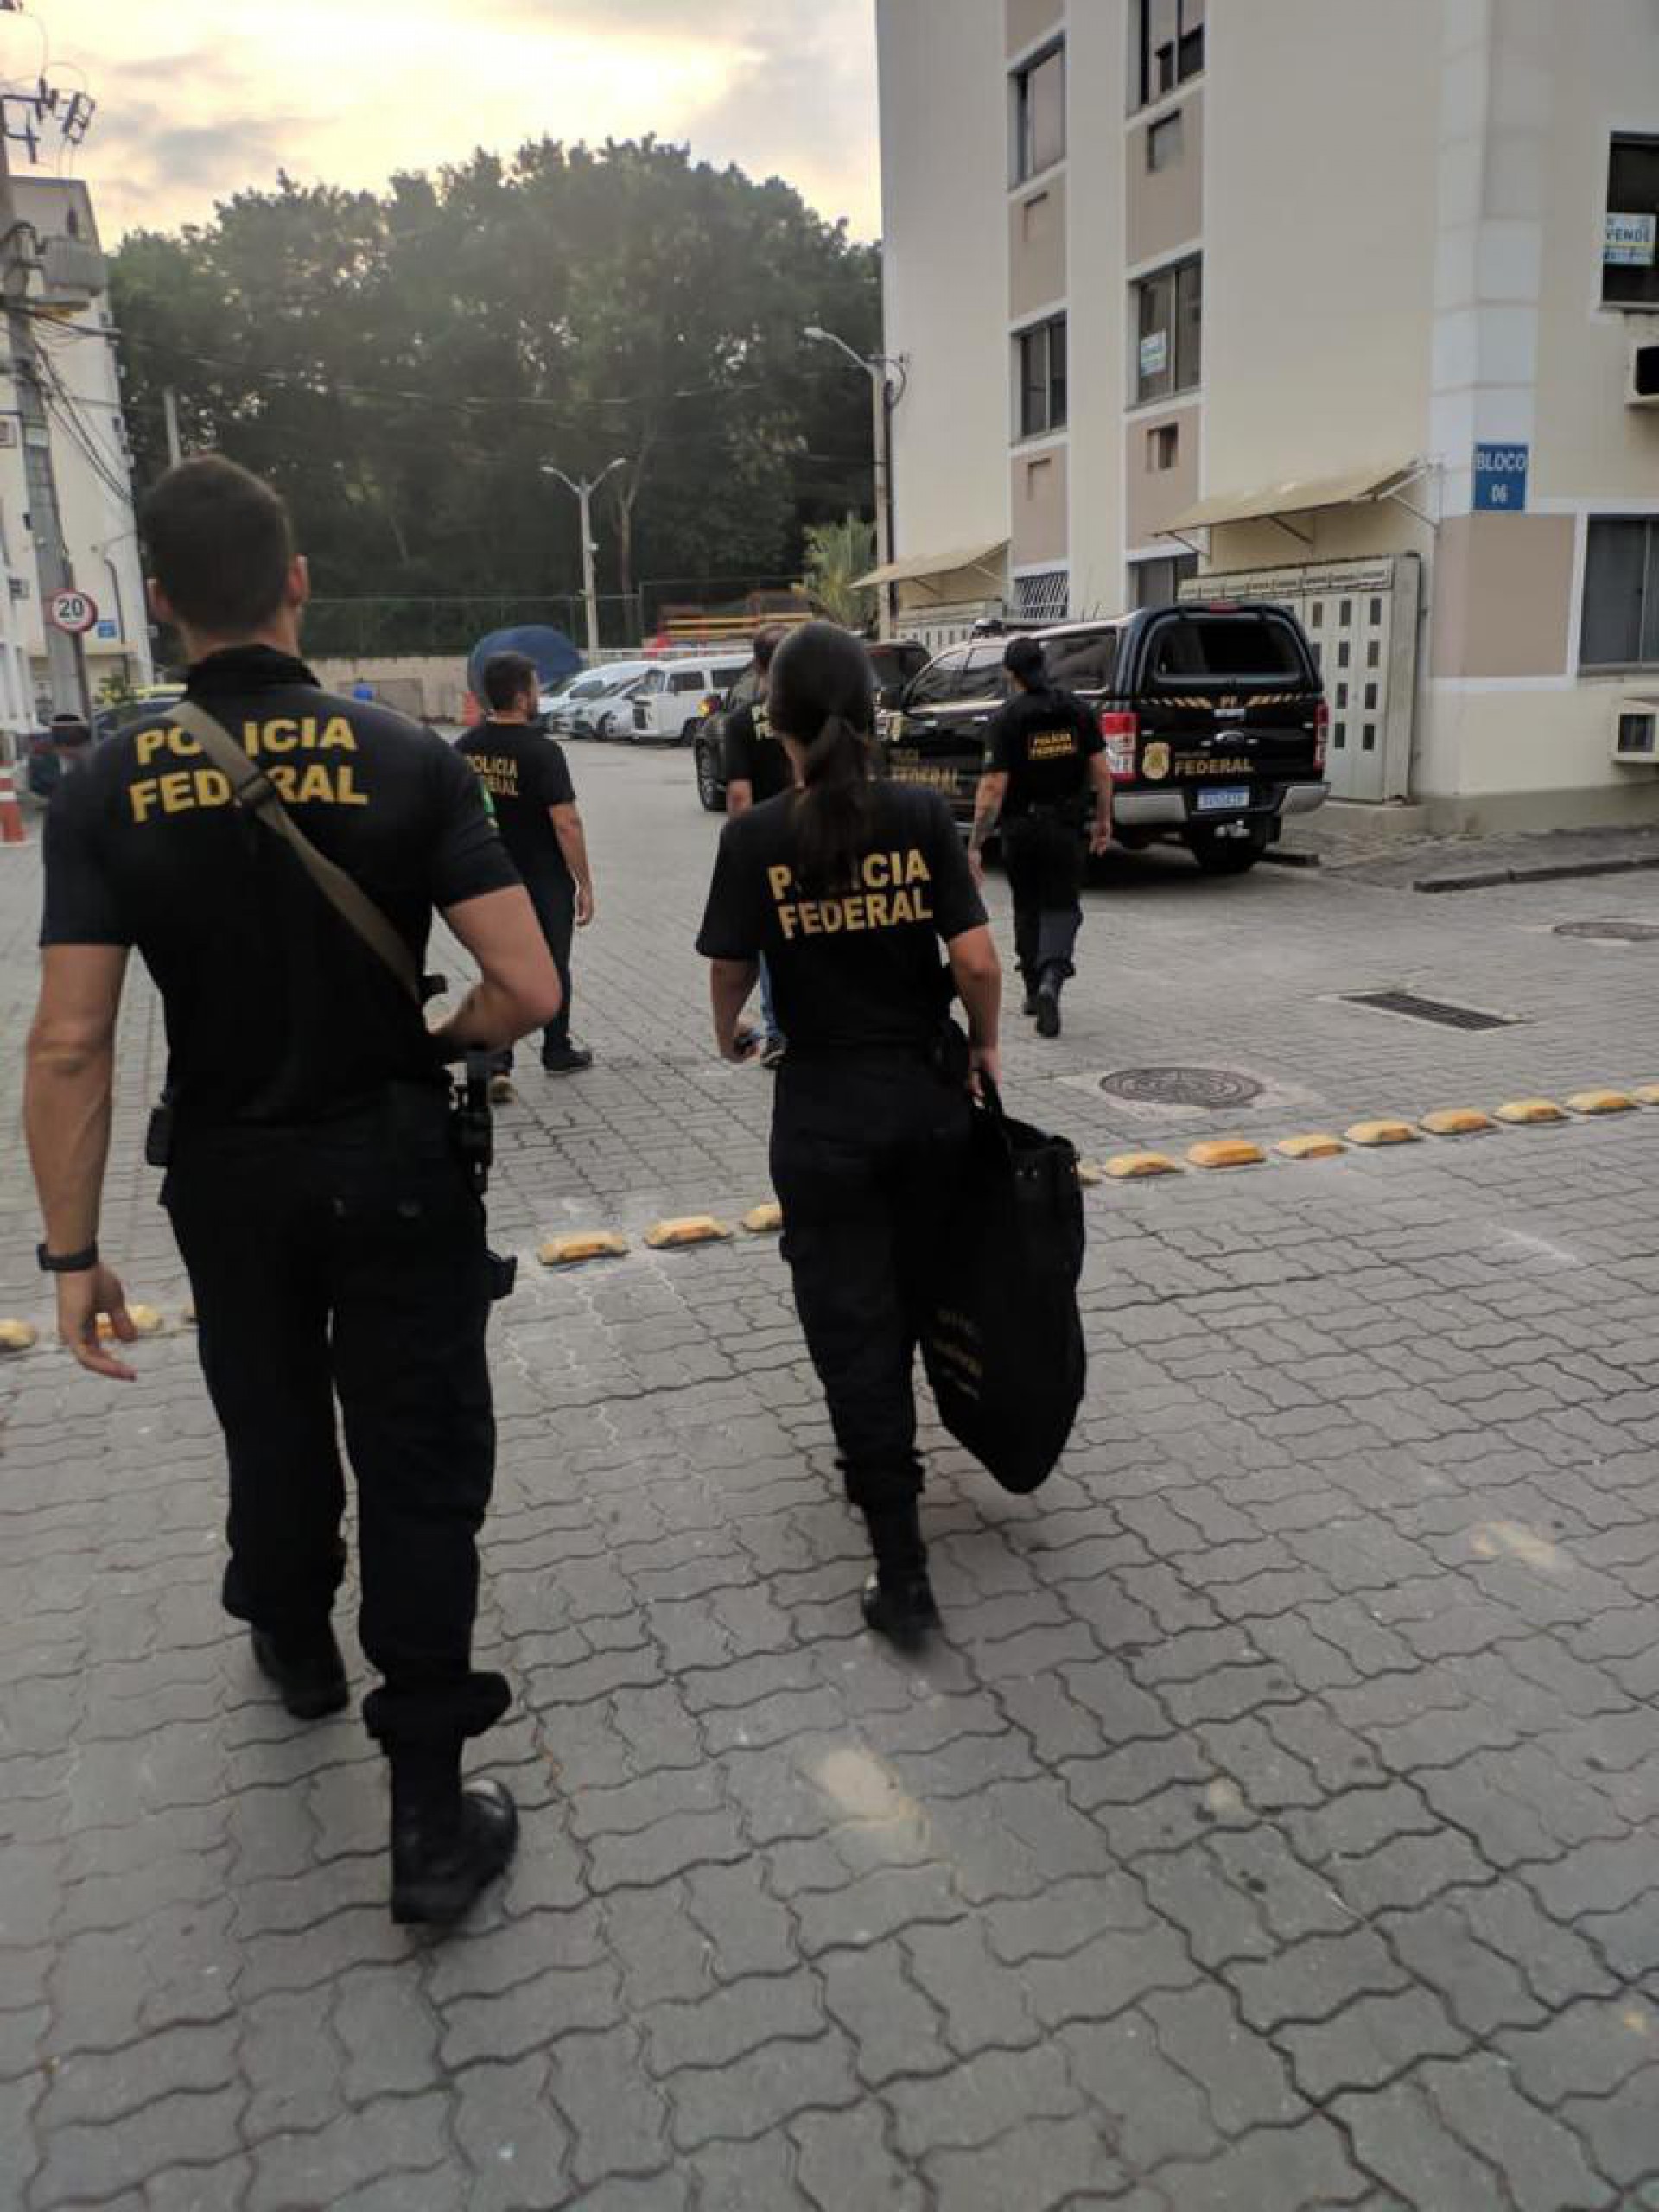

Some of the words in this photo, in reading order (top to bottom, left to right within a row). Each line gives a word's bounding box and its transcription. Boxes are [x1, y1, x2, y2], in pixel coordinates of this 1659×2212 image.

[1477, 452, 1526, 472] BLOCO
[59, 598, 84, 618] 20
[135, 716, 359, 766] POICIA
[1175, 758, 1255, 777] FEDERAL
[129, 764, 369, 823] FEDRAL
[779, 887, 934, 939] FEDERAL
